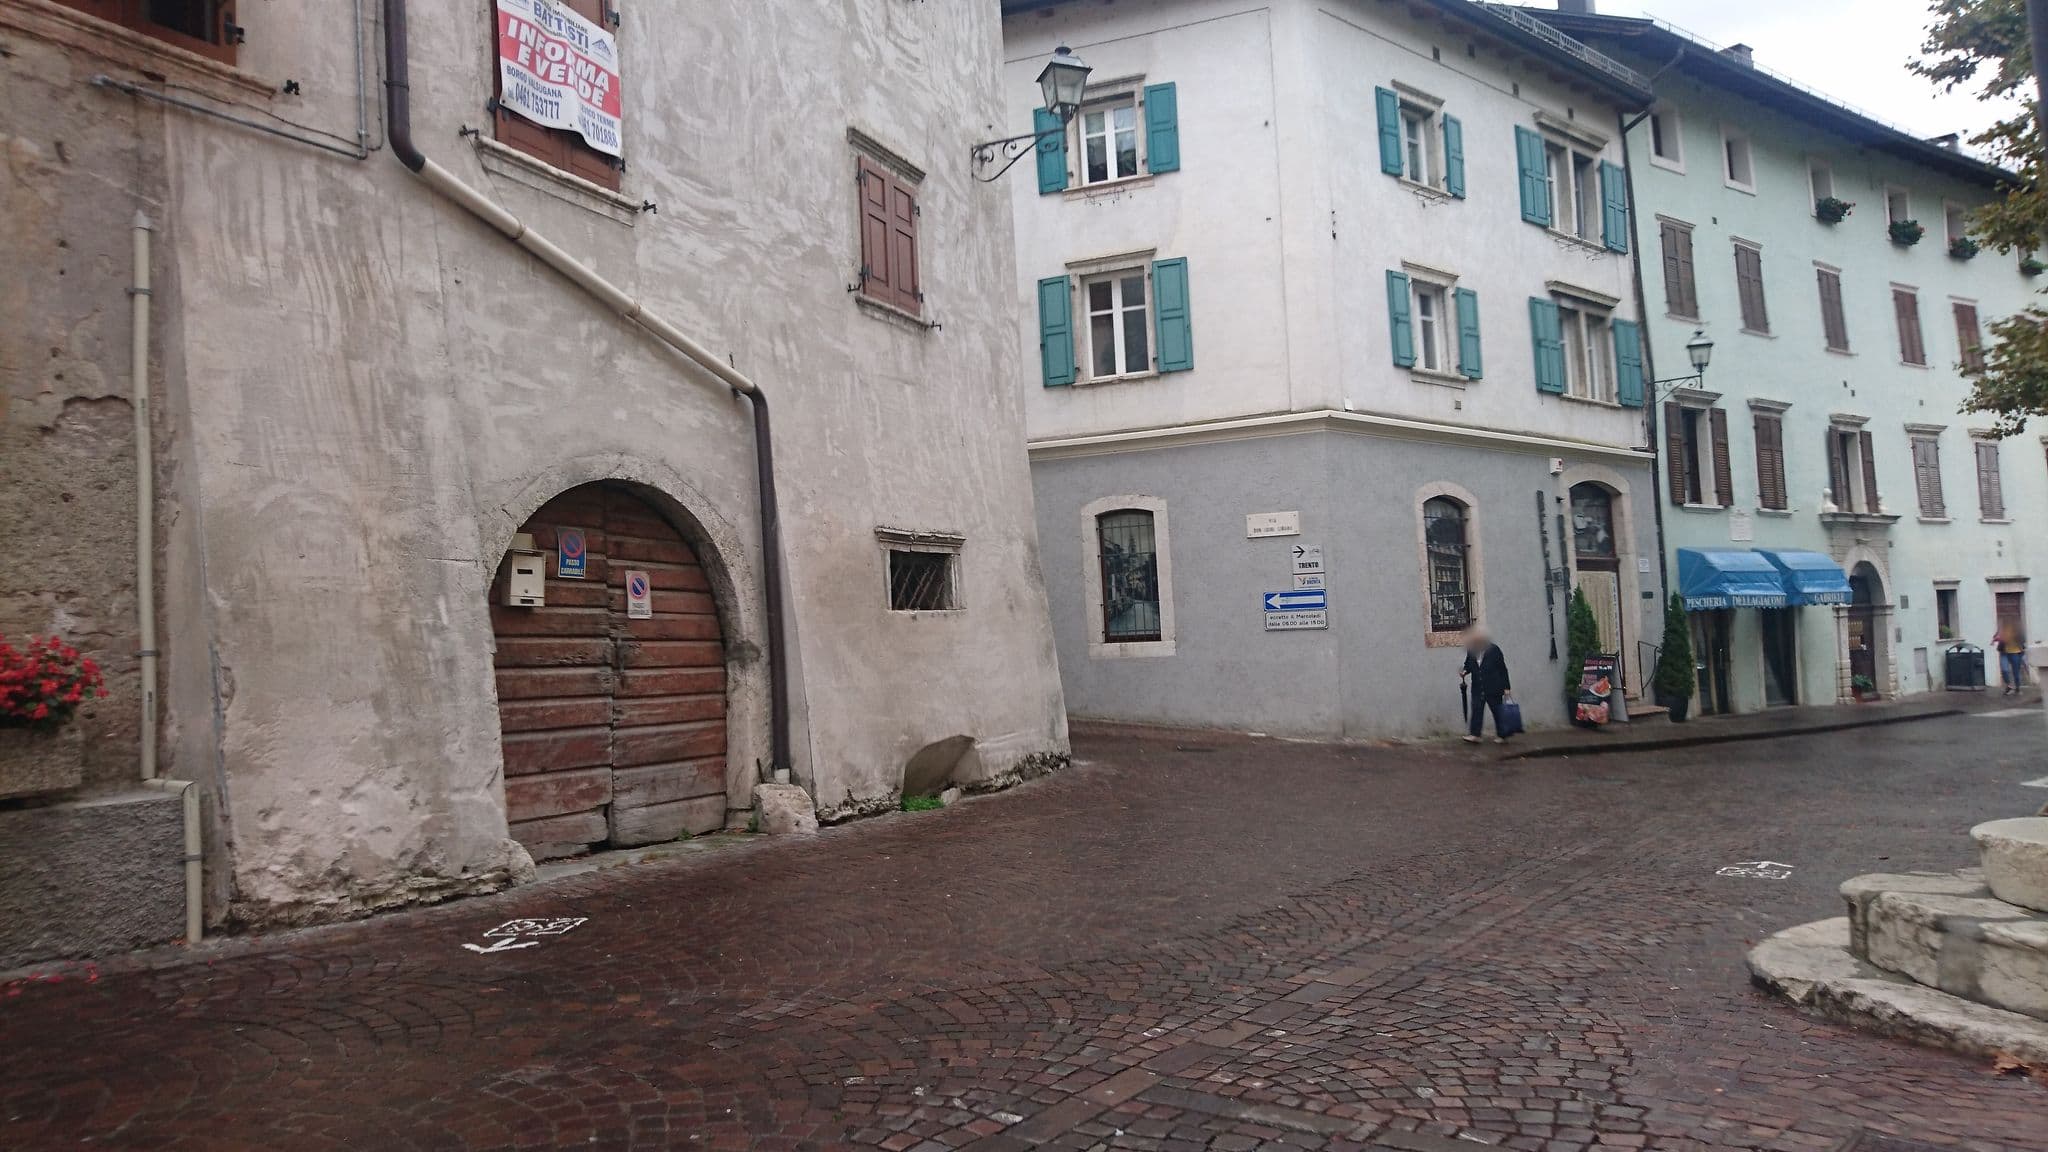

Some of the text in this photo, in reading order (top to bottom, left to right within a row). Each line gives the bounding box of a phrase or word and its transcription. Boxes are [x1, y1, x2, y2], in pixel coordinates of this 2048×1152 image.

[534, 0, 588, 49] BATTISTI
[507, 17, 609, 93] INFORMA
[506, 65, 562, 98] BORGO VALSUGANA
[518, 44, 605, 108] E VENDE
[515, 83, 530, 109] 0461
[532, 93, 560, 120] 753777
[581, 104, 597, 120] EVICO
[1686, 596, 1727, 608] PESCHERIA
